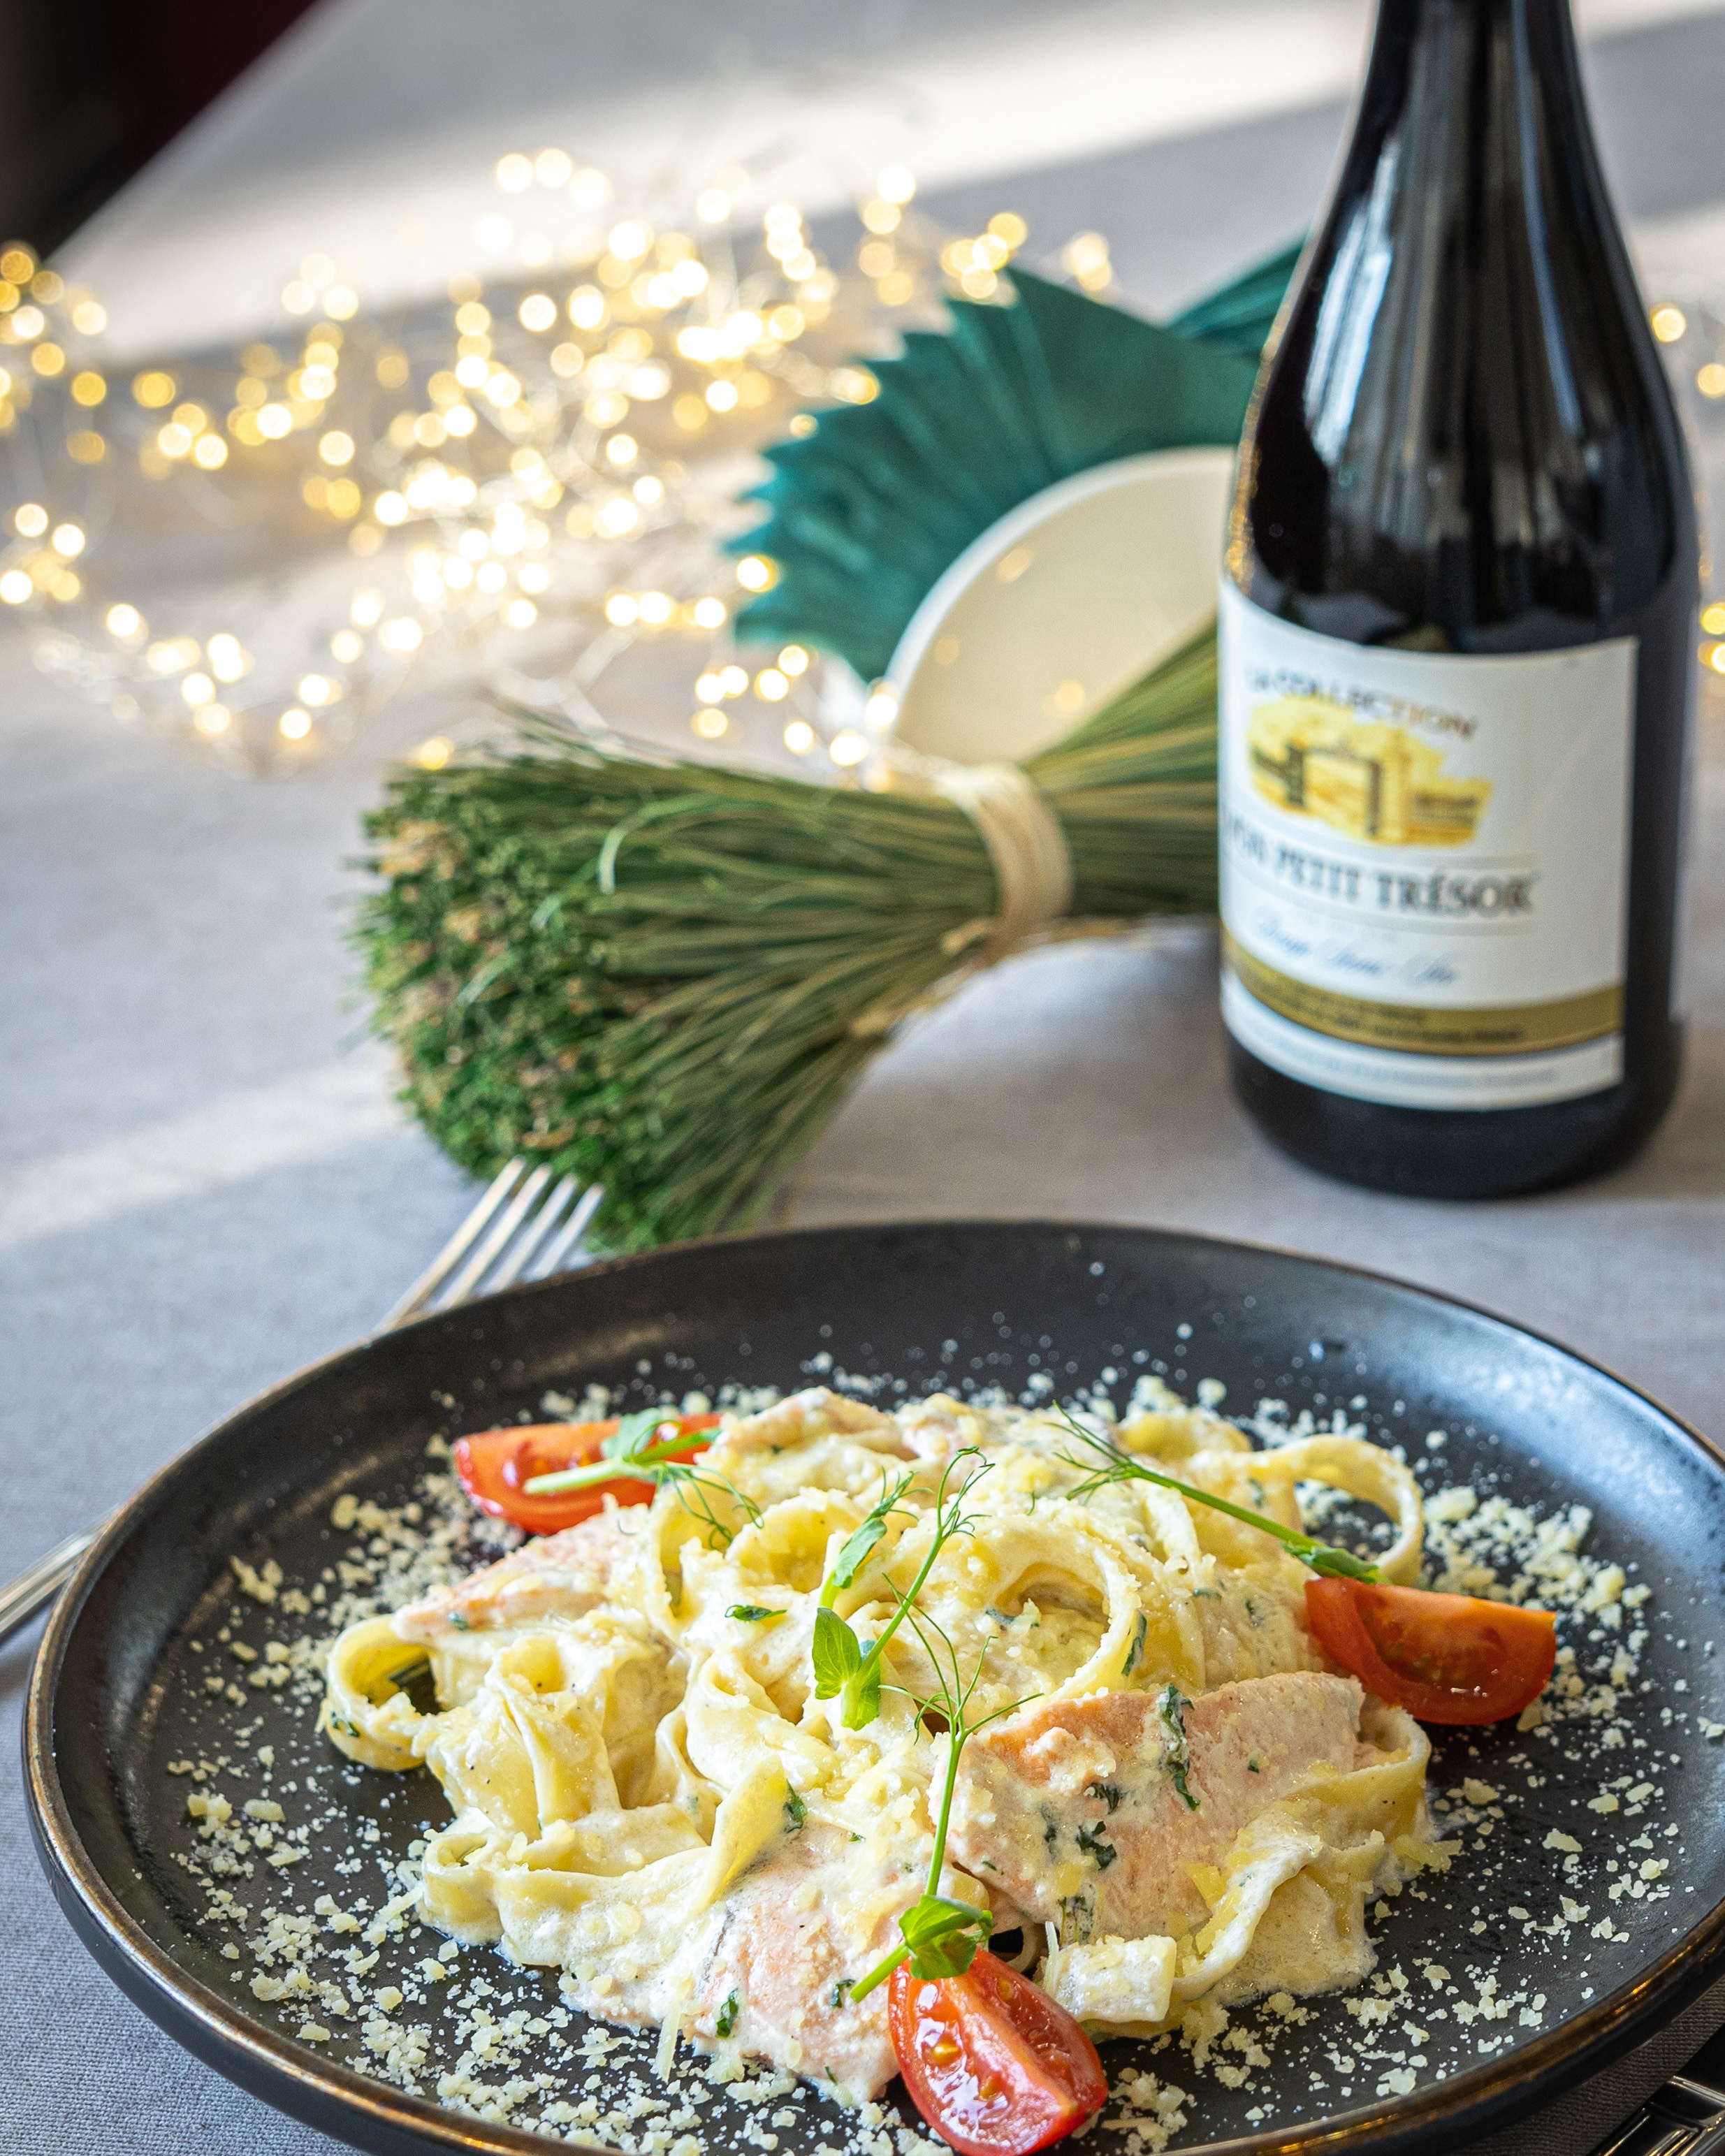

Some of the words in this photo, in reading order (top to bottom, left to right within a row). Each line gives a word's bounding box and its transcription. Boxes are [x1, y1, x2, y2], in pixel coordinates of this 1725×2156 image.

[1272, 667, 1477, 742] COLLECTION
[1275, 843, 1360, 903] PETIT
[1376, 866, 1536, 917] TRÉSOR
